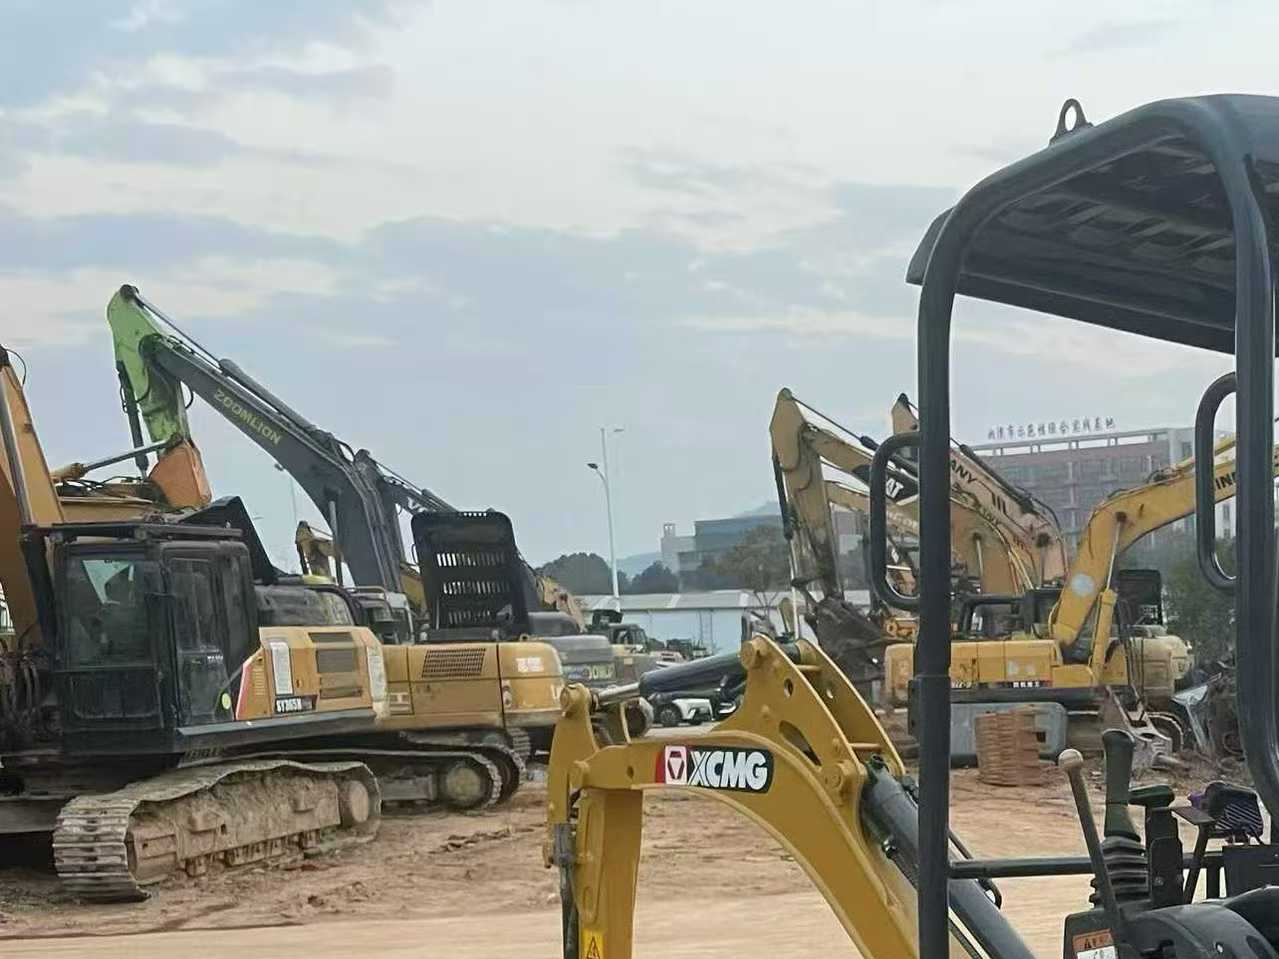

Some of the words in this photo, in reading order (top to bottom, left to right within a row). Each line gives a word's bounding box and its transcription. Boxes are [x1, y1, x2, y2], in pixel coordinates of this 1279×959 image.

[214, 388, 283, 445] ZOOMLION
[950, 458, 978, 484] ANY
[886, 477, 905, 499] AT
[687, 750, 768, 790] XCMG
